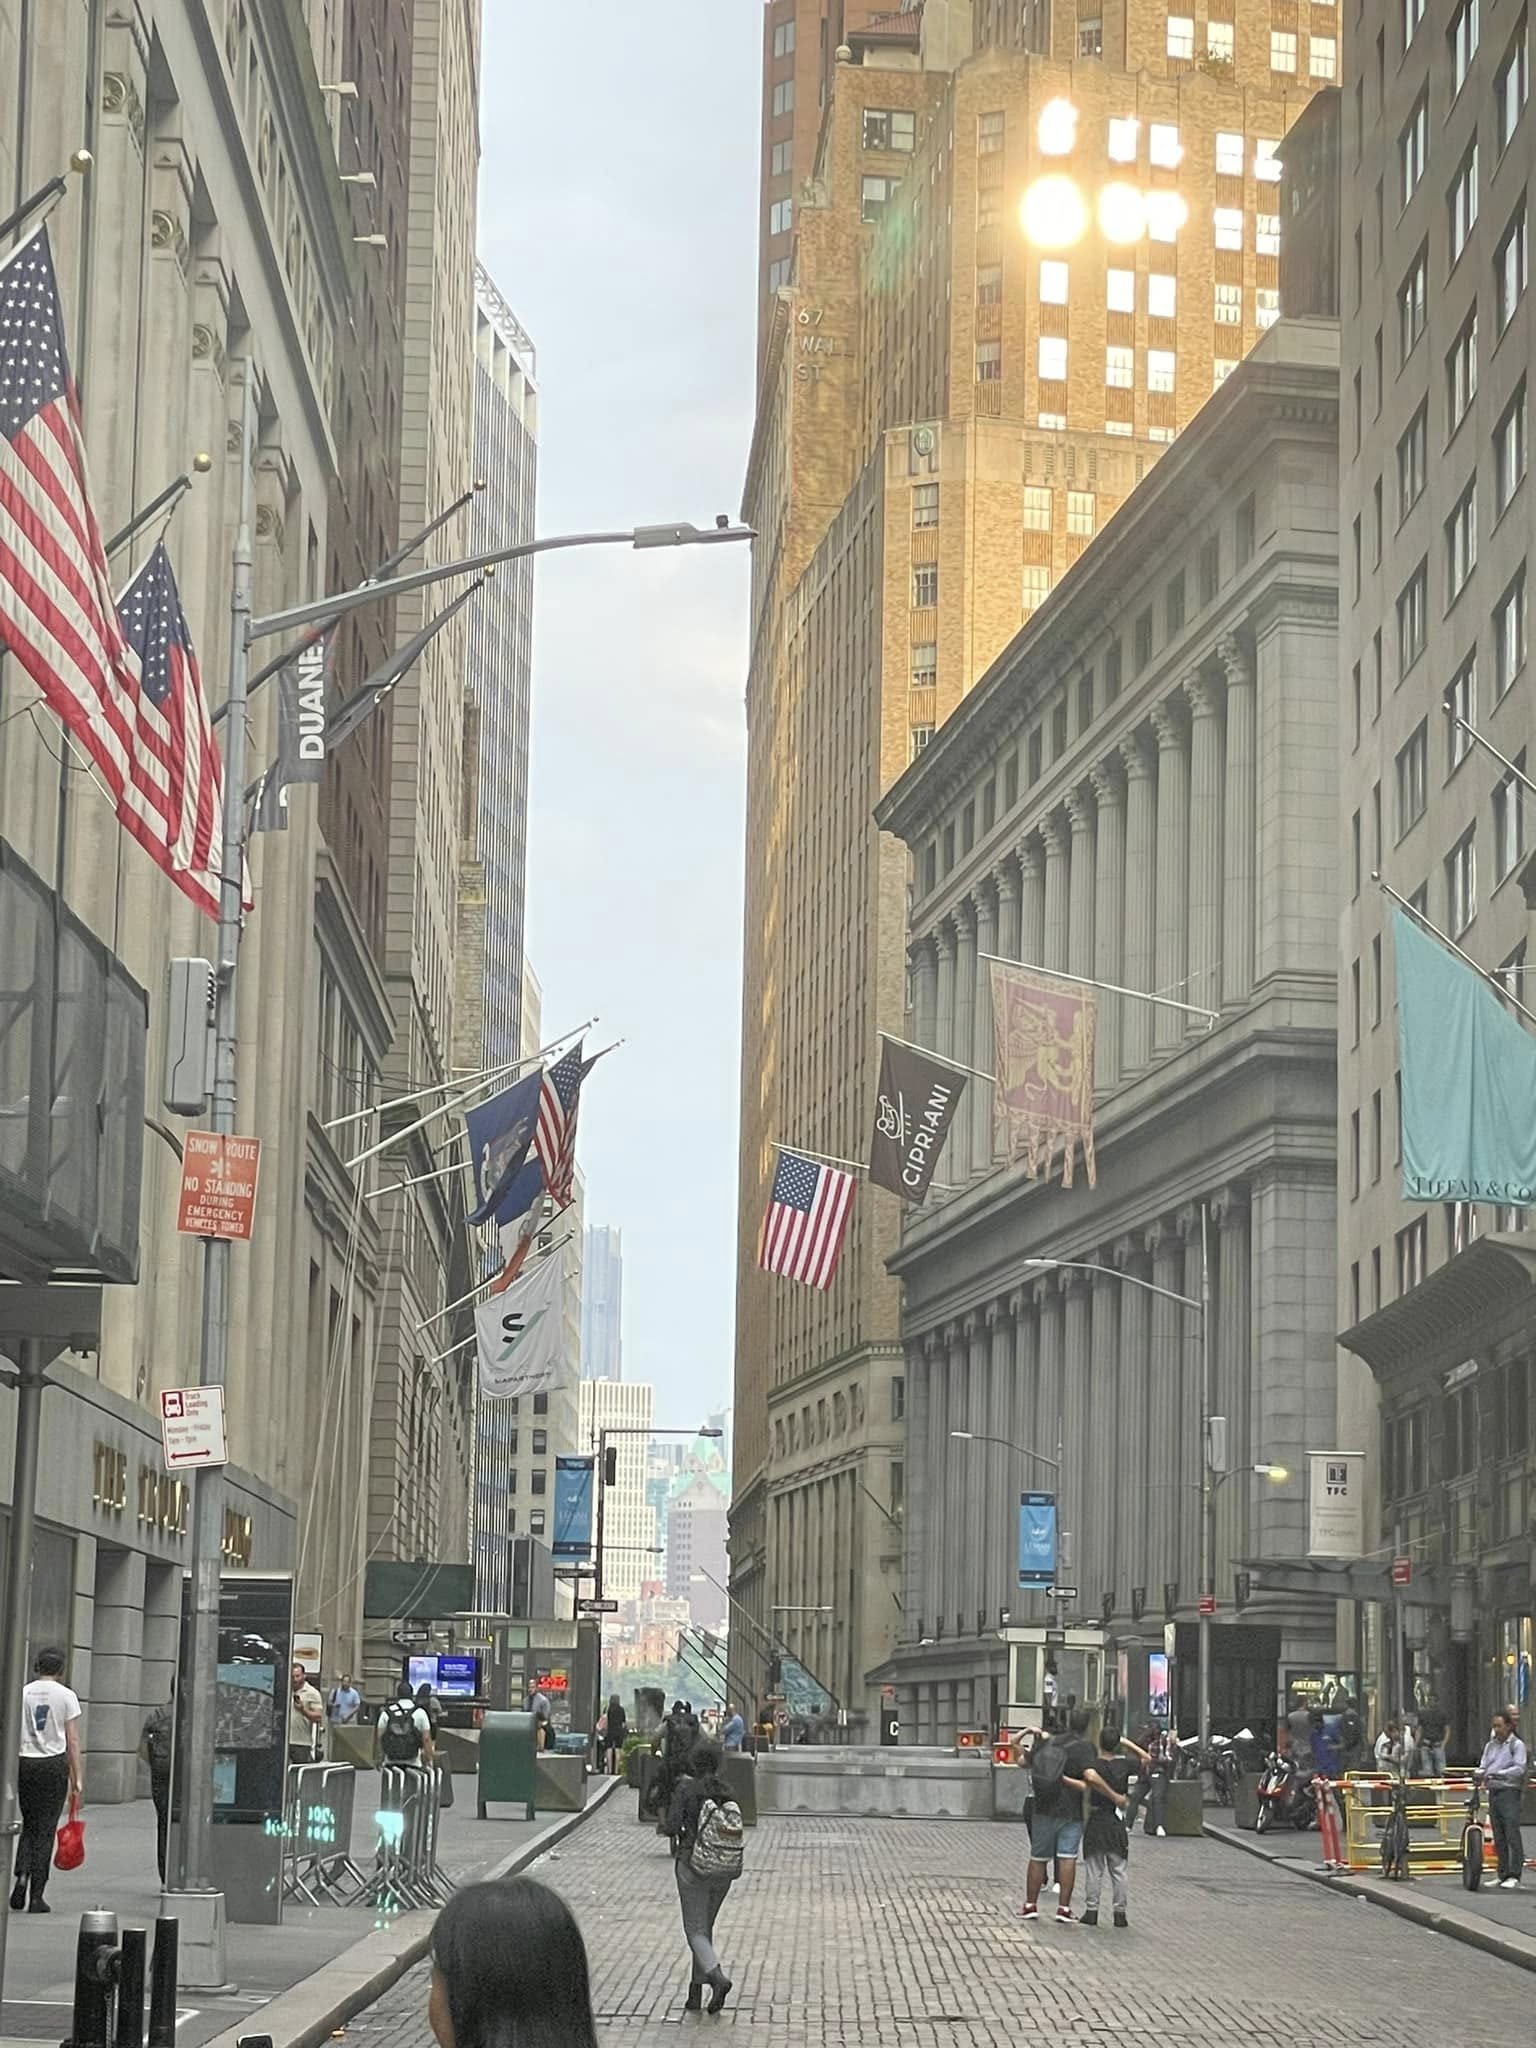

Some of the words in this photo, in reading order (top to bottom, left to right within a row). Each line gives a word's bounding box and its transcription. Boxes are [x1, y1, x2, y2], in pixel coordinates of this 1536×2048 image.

[799, 306, 824, 326] 67
[796, 363, 824, 381] ST
[299, 646, 325, 760] DUANE
[902, 1084, 952, 1187] CIPRIANI
[188, 1138, 218, 1155] SNOW
[225, 1143, 257, 1160] ROUTE
[184, 1176, 199, 1191] NO
[204, 1179, 253, 1198] STANDING
[1412, 1176, 1484, 1196] TIFFAY
[200, 1194, 235, 1208] DURING
[187, 1205, 244, 1221] EMERGENCY
[185, 1217, 217, 1231] VEHICLES
[220, 1221, 244, 1233] TOWED
[185, 1392, 200, 1400] Truck
[185, 1401, 208, 1409] Loading
[93, 1440, 127, 1509] THE
